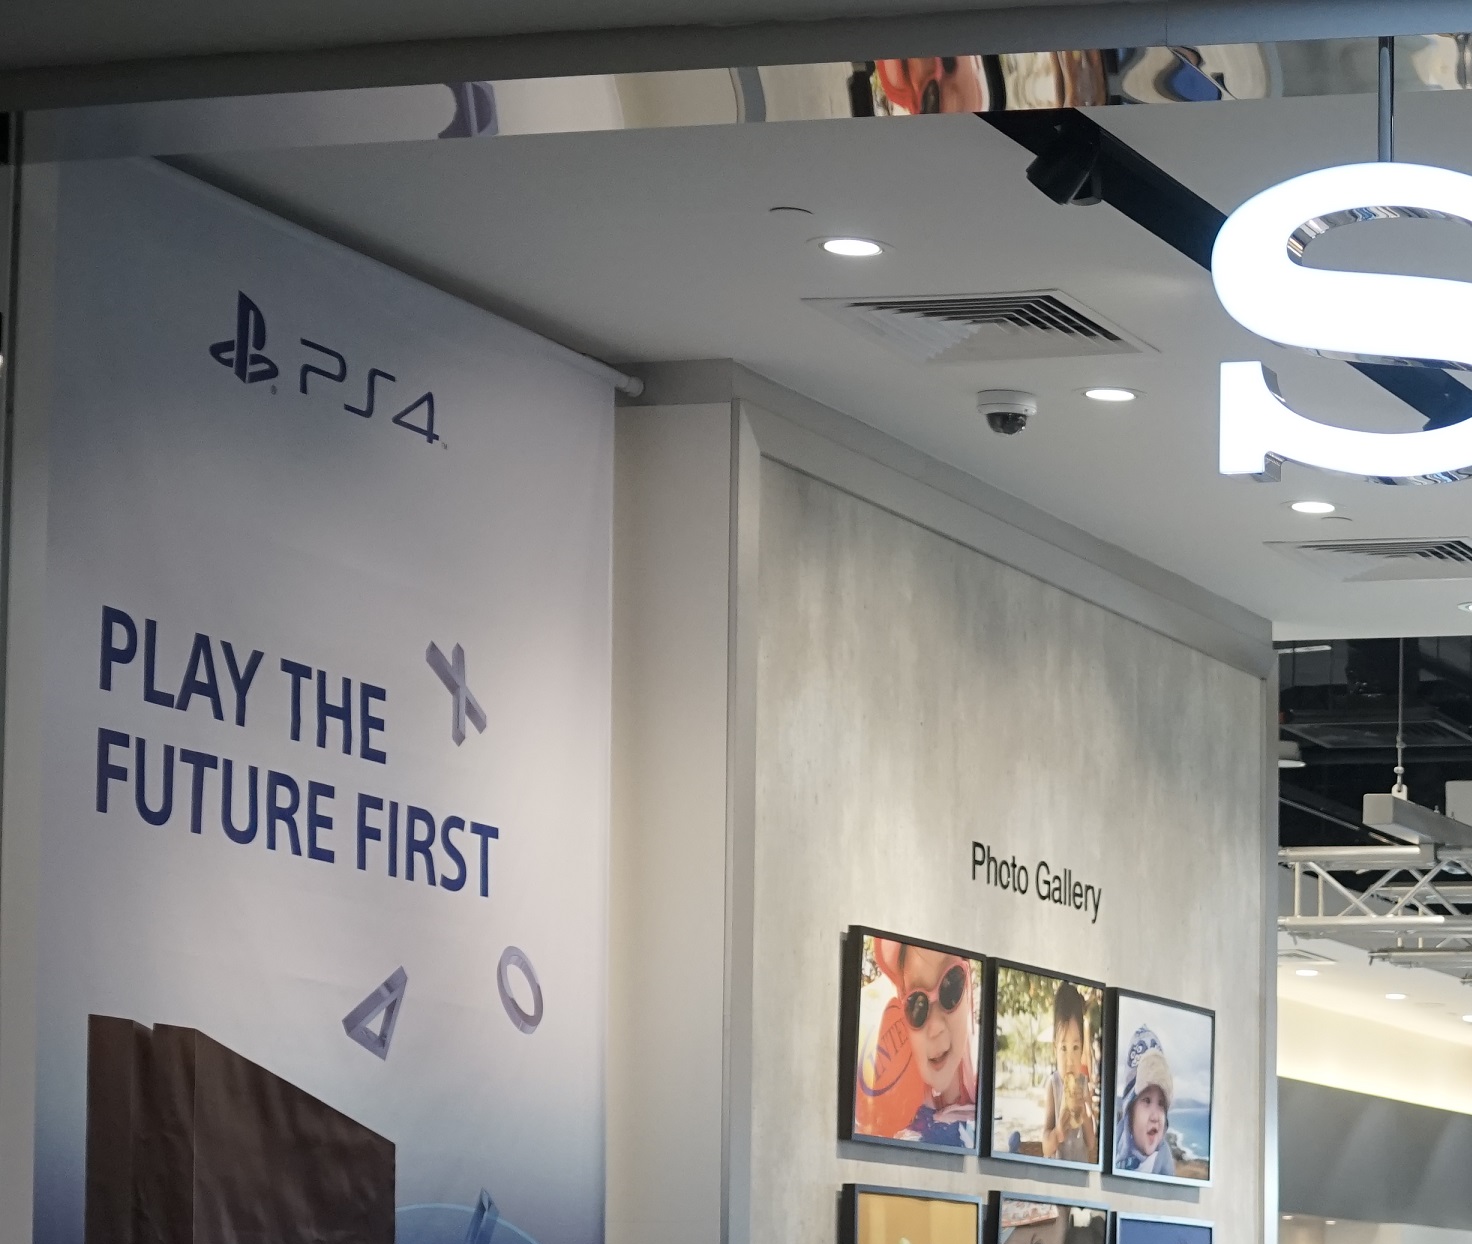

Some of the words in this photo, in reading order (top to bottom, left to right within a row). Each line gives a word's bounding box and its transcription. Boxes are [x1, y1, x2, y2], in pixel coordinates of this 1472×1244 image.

[300, 337, 440, 444] PS4
[100, 605, 265, 727] PLAY
[280, 658, 387, 765] THE
[96, 727, 335, 864] FUTURE
[356, 793, 499, 898] FIRST
[971, 840, 1029, 895] Photo
[1035, 860, 1102, 924] Gallery
